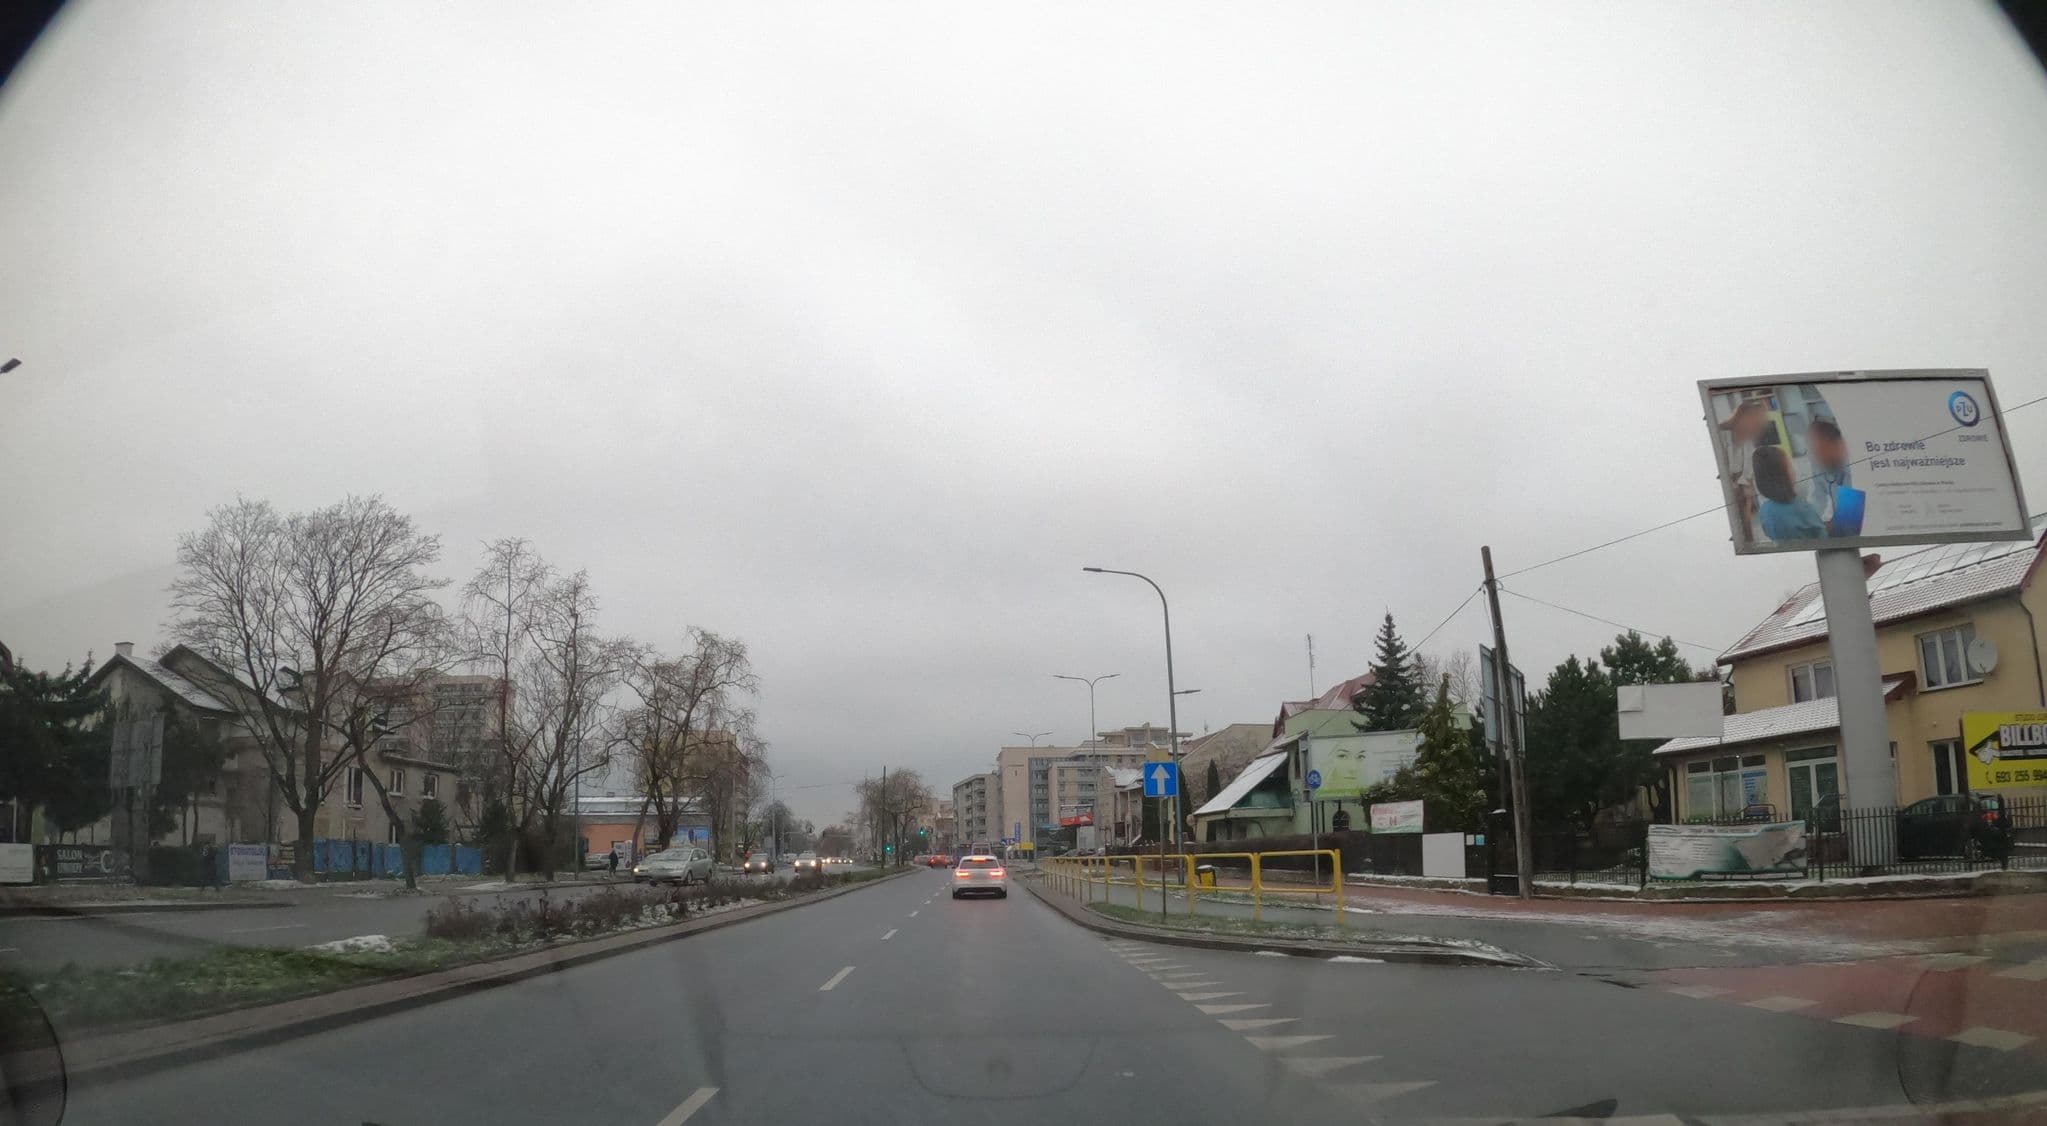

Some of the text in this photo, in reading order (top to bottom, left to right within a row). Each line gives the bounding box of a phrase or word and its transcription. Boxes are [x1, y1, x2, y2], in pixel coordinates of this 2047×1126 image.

[1956, 401, 1974, 417] PZU
[1865, 440, 1926, 452] Bo zdrowie
[1870, 456, 1966, 471] jest najważniejsze
[56, 848, 83, 860] SALON
